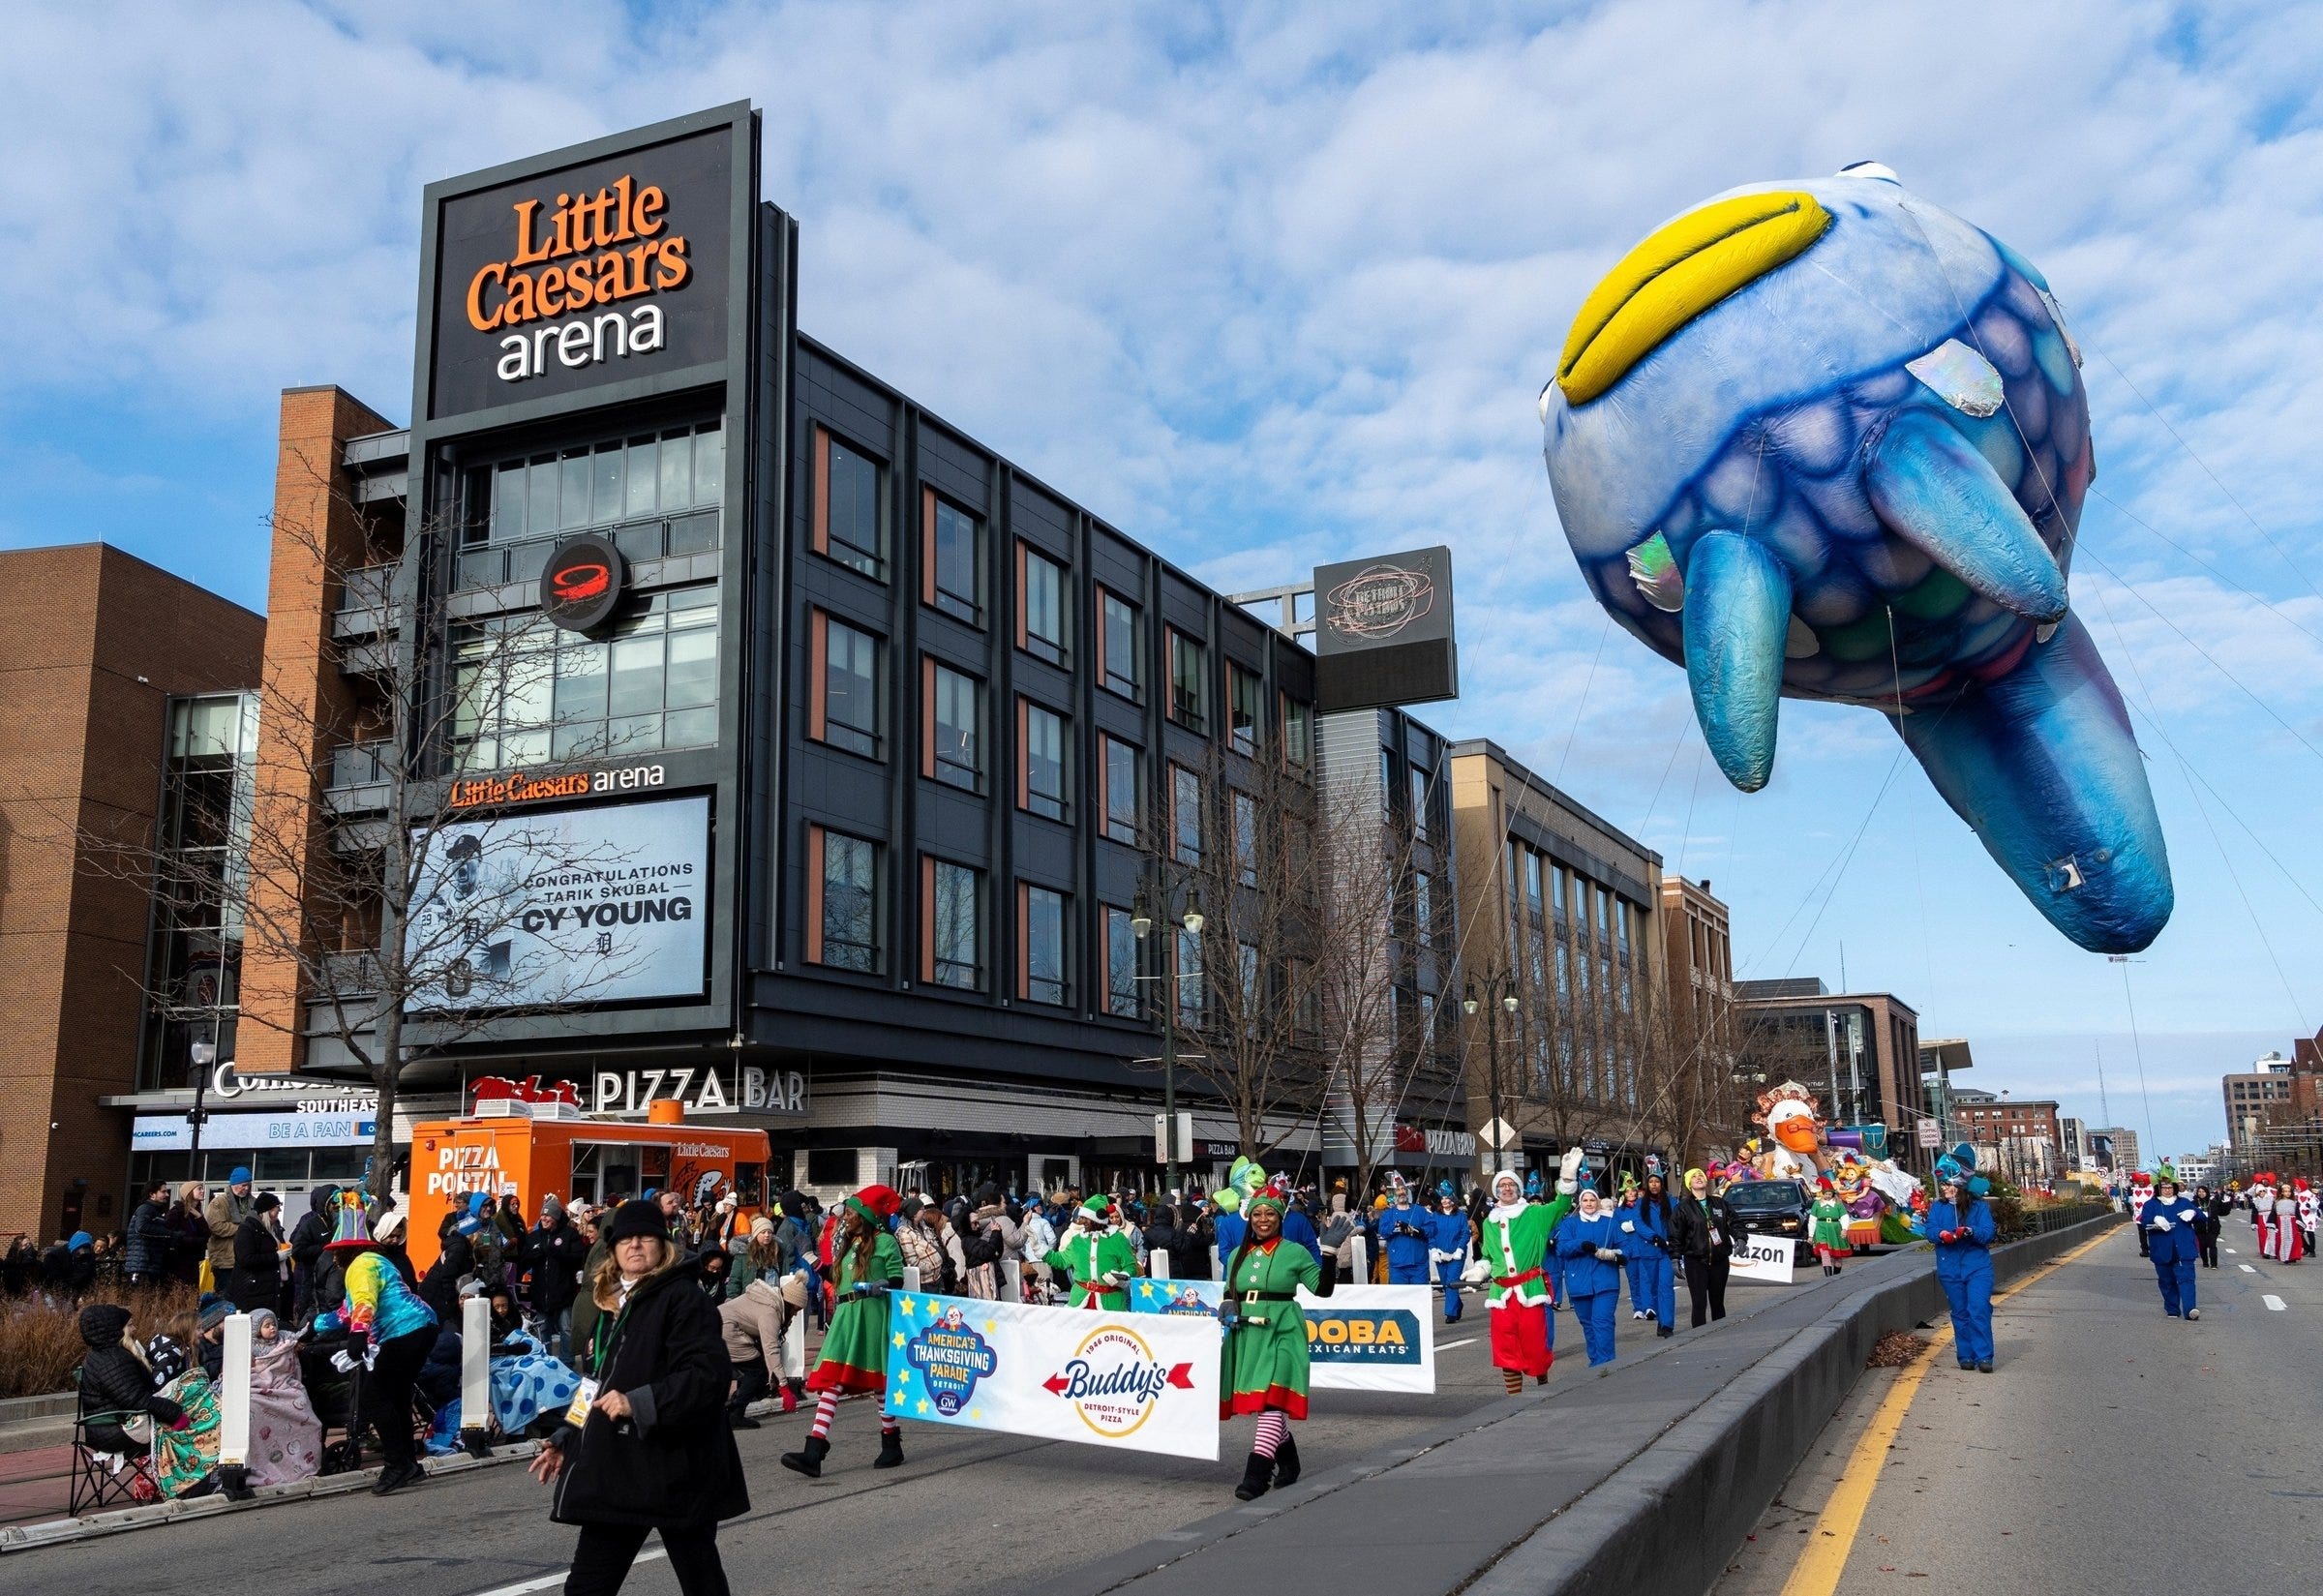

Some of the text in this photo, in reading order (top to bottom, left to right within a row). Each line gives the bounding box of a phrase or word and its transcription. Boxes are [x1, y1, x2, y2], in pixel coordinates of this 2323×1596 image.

[510, 175, 665, 268] Little
[467, 236, 688, 331] Caesars
[498, 304, 666, 381] arena
[450, 765, 665, 807] Little Caesars arena
[525, 863, 693, 889] CONGRATULATIONS
[545, 883, 670, 903] TARIK SKUBAL
[522, 896, 692, 933] CY YOUNG
[597, 1068, 727, 1112] PIZZA
[744, 1067, 804, 1111] BAR
[296, 1099, 379, 1114] SOUTHEAS
[269, 1123, 290, 1138] BE
[294, 1123, 308, 1138] A
[313, 1122, 351, 1138] FAN
[677, 1142, 731, 1158] Little Caesars
[1208, 1143, 1223, 1155] PIZZA
[1224, 1144, 1236, 1155] BAR
[1425, 1129, 1456, 1155] PIZZA
[1455, 1131, 1476, 1156] BAR
[438, 1146, 500, 1171] PIZZA
[428, 1171, 506, 1196] PORTAL
[1734, 1247, 1784, 1263] azon
[1306, 1319, 1405, 1344] OBA
[928, 1334, 976, 1350] AMERICA'S
[1086, 1335, 1140, 1355] 1946 ORIGINAL
[1309, 1344, 1361, 1354] XICAN
[914, 1344, 989, 1371] THANKSGIVING
[930, 1363, 970, 1383] PARADE
[1064, 1360, 1166, 1403] Buddy's
[933, 1380, 965, 1391] DETROIT
[941, 1397, 956, 1408] GW
[1084, 1403, 1140, 1416] DETROIT-STYLE
[1101, 1415, 1123, 1424] PIZZA
